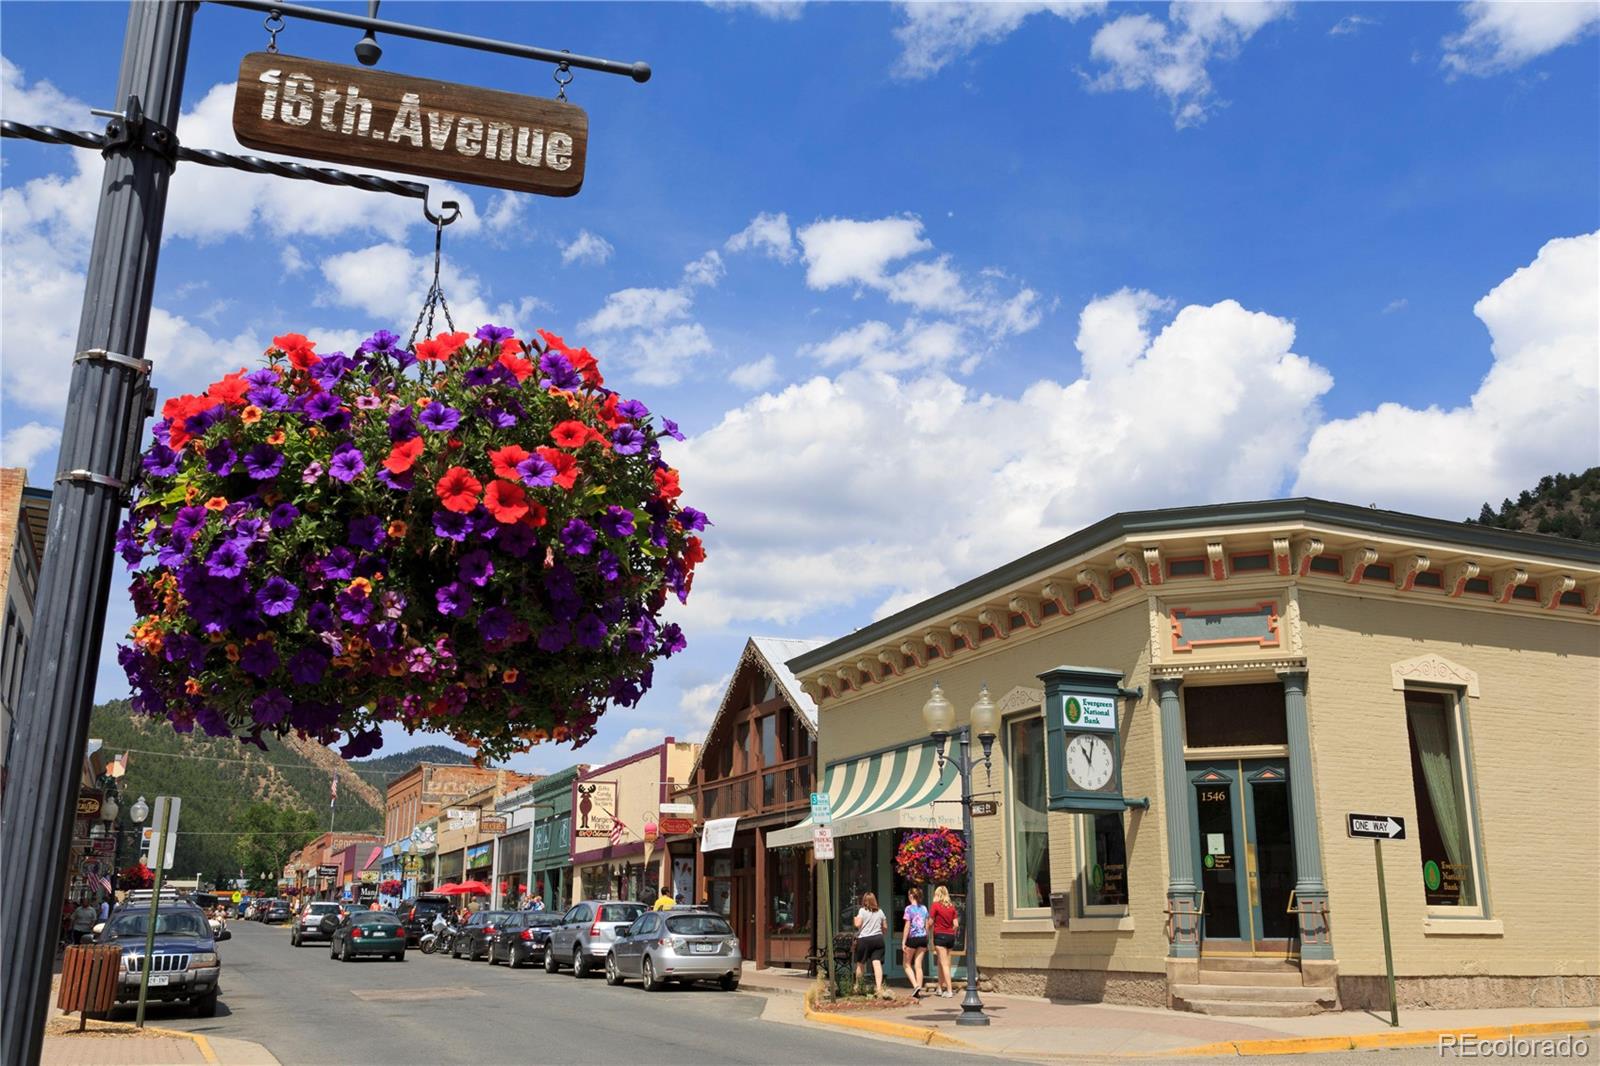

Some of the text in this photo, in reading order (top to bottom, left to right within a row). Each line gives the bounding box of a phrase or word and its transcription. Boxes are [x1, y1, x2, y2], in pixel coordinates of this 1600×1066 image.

[259, 68, 574, 172] 16th.Avenue
[1082, 699, 1113, 708] Evergreen
[1084, 707, 1110, 716] National
[1084, 716, 1101, 725] Bank
[1201, 791, 1226, 801] 1546
[1355, 821, 1388, 832] ONE WAY
